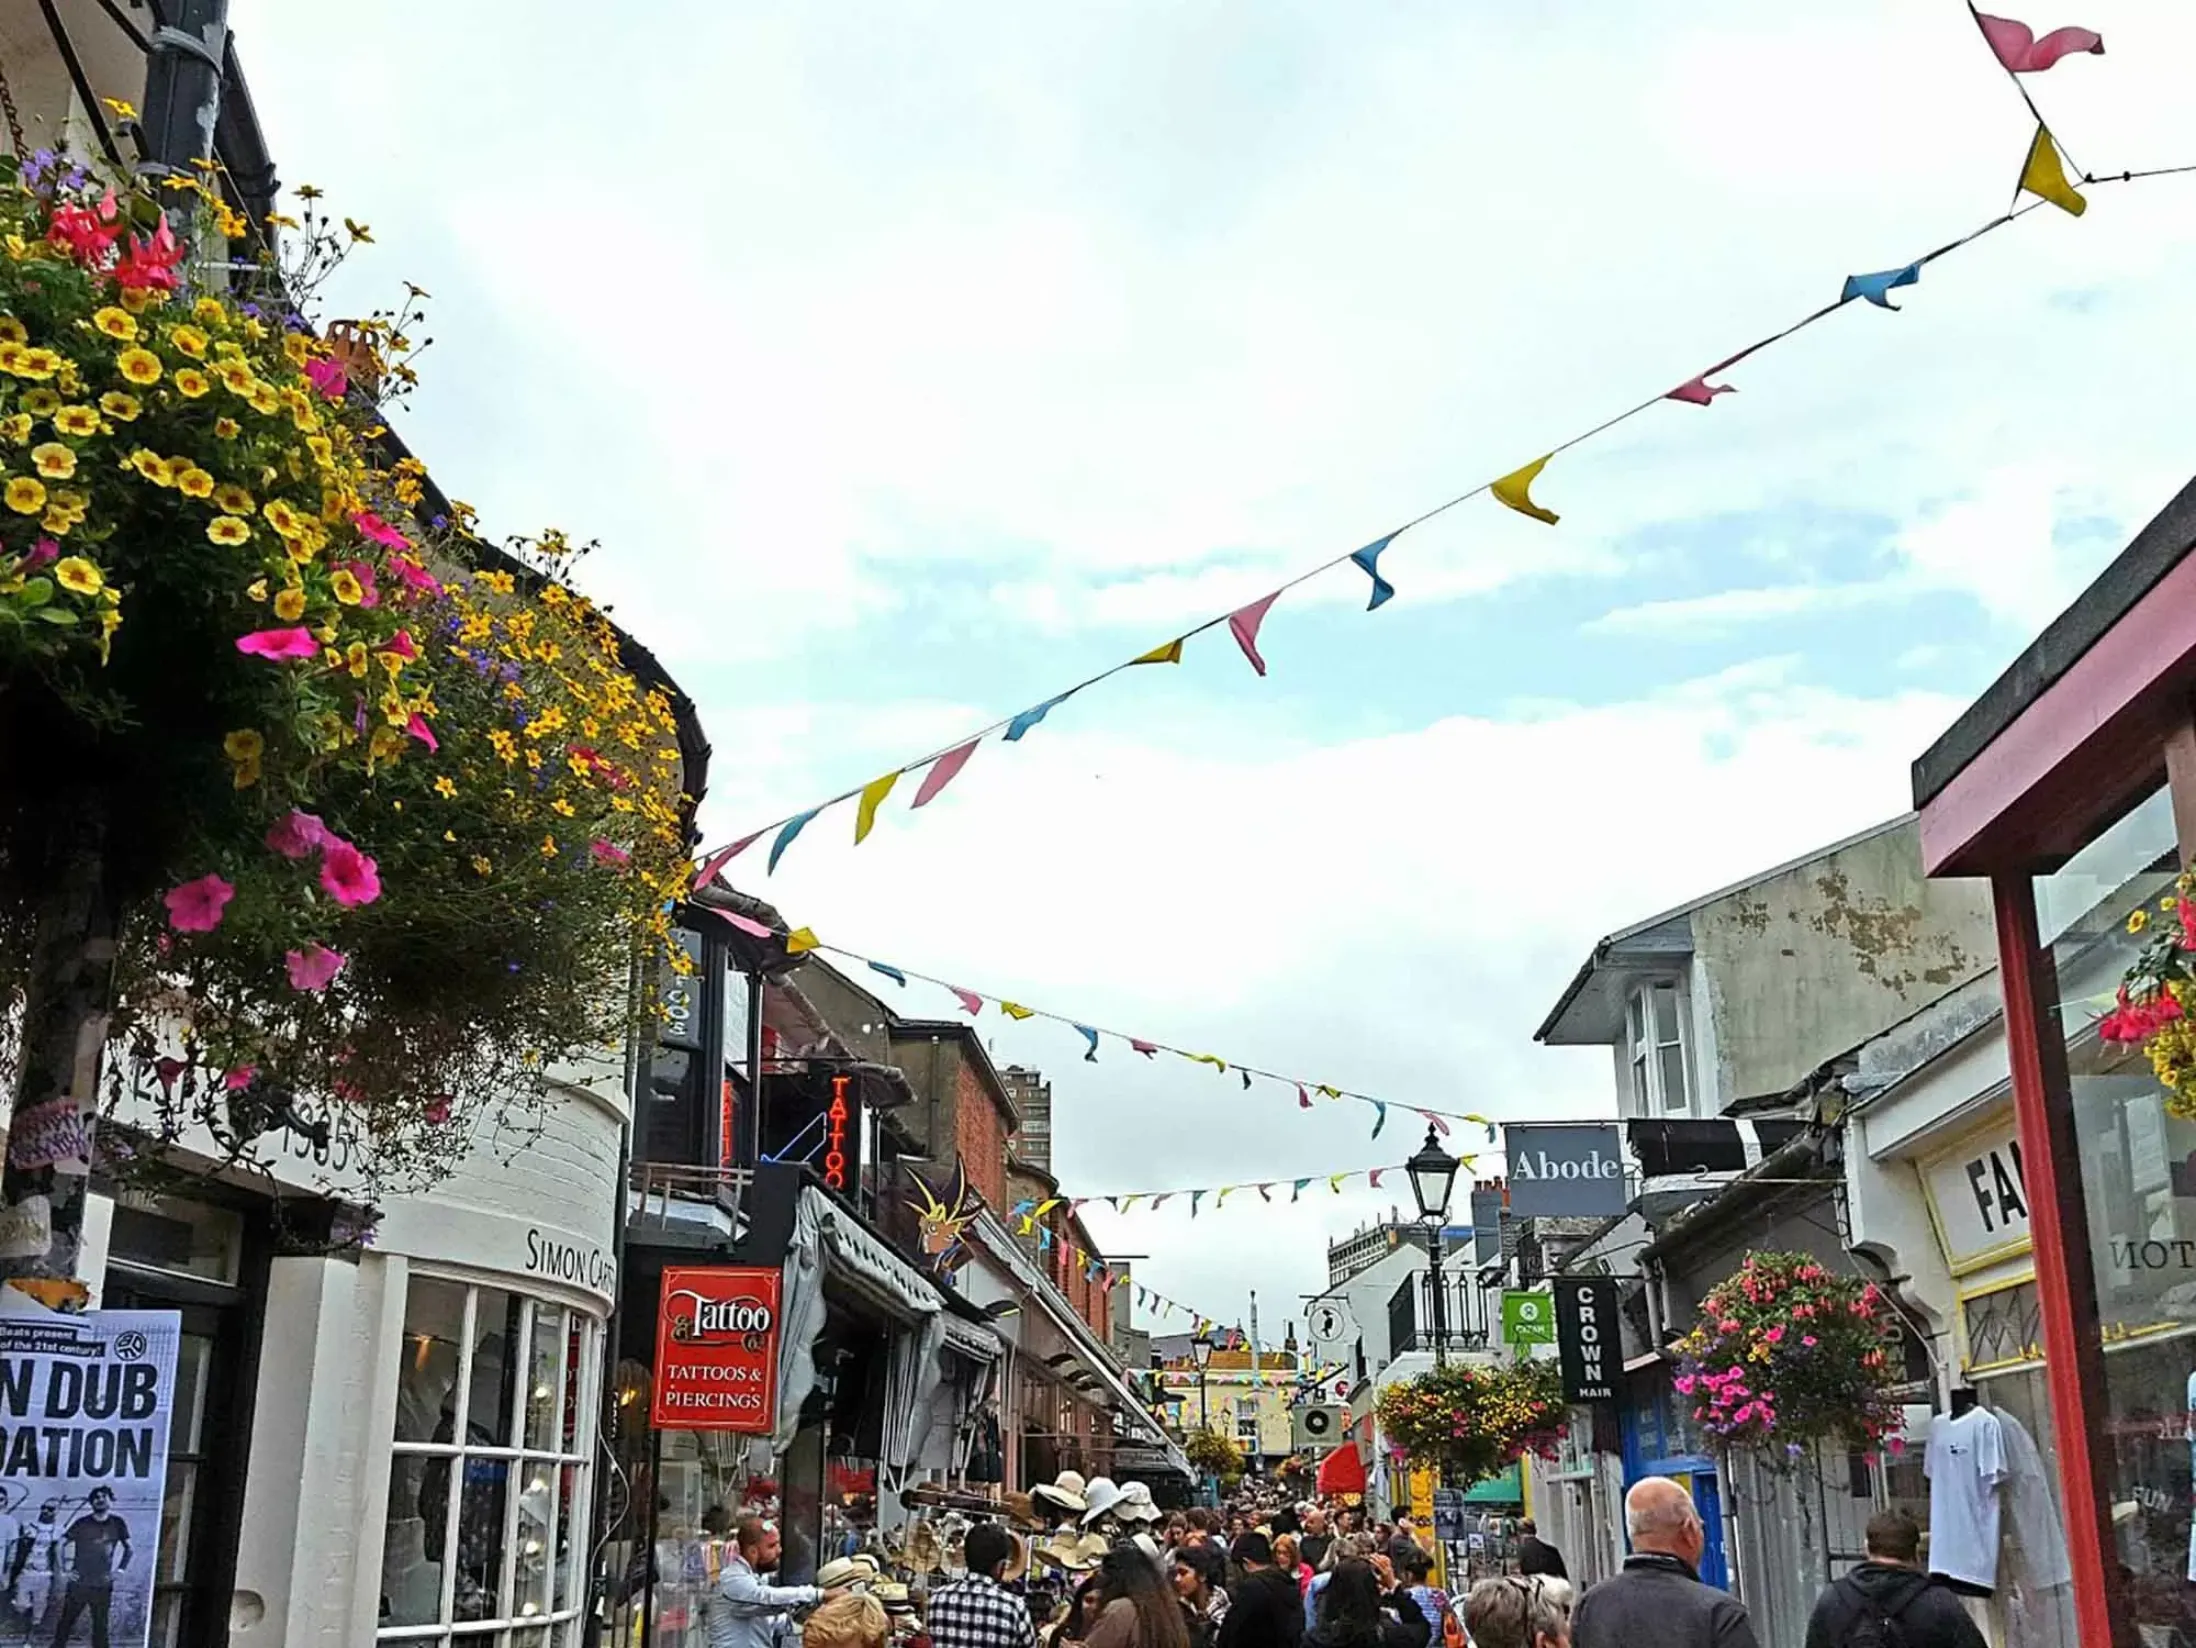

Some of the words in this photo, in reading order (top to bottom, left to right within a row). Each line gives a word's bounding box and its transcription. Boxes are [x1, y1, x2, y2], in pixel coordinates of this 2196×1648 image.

[824, 1076, 852, 1189] TATTOO
[1511, 1150, 1619, 1179] Abode
[1966, 1140, 2028, 1232] FA
[526, 1228, 586, 1284] SIMON
[32, 1328, 74, 1340] present
[664, 1289, 772, 1337] Tattoo
[1577, 1286, 1602, 1381] CROWN
[13, 1340, 33, 1351] the
[34, 1341, 58, 1352] 21st
[44, 1360, 158, 1420] DUB
[668, 1364, 747, 1382] TATTOOS
[750, 1368, 762, 1381] &
[1579, 1387, 1611, 1397] HAIR
[666, 1391, 762, 1408] PIERCINGS
[0, 1426, 154, 1478] ATION
